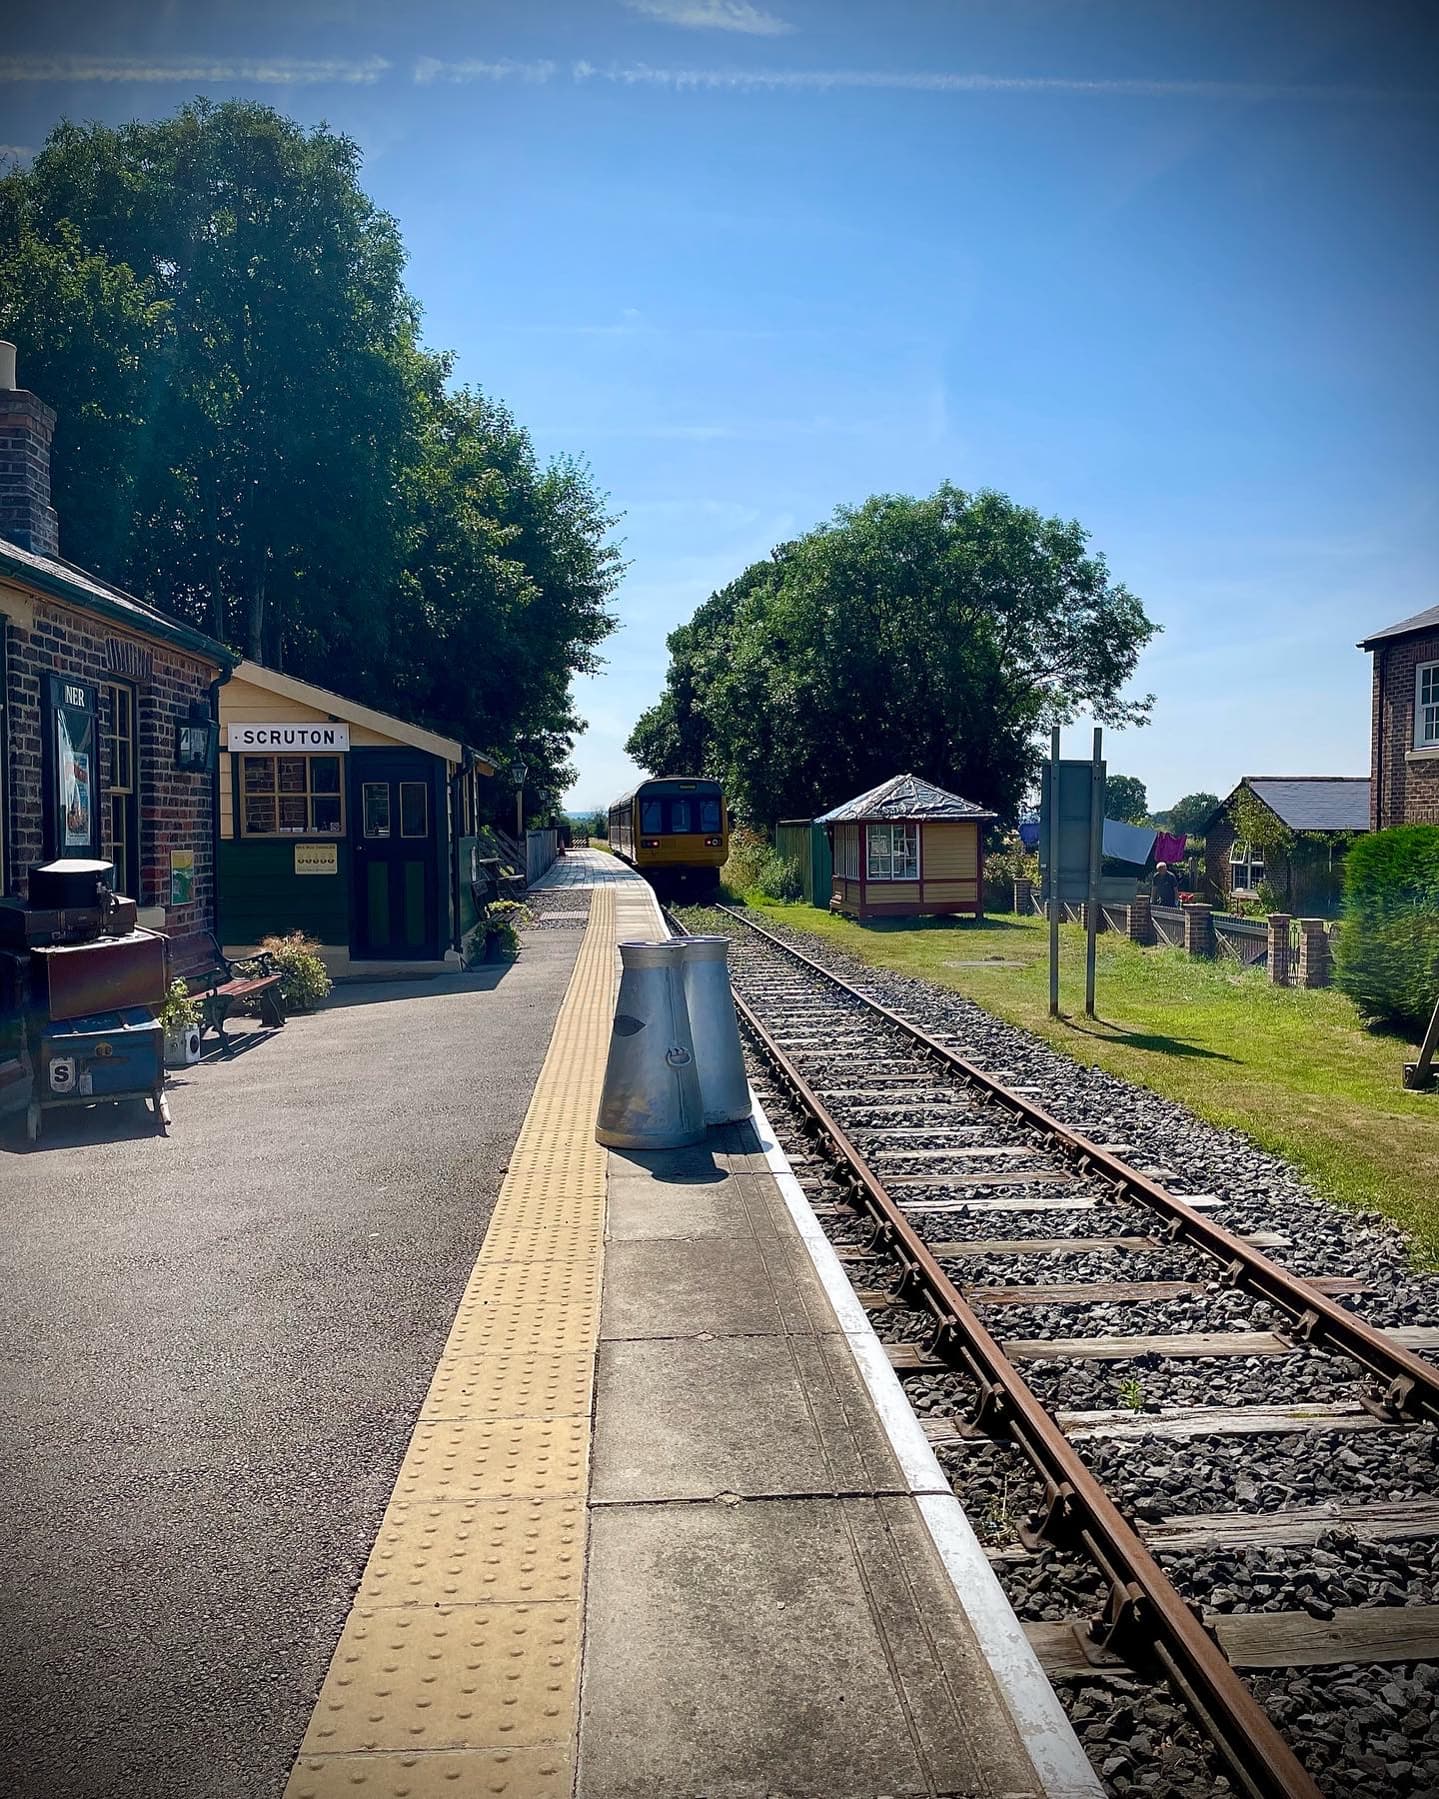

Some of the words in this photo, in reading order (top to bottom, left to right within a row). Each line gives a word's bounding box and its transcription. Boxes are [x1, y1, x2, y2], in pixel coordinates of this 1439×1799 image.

[64, 685, 85, 707] NER
[243, 730, 335, 744] SCRUTON
[54, 1065, 69, 1082] S
